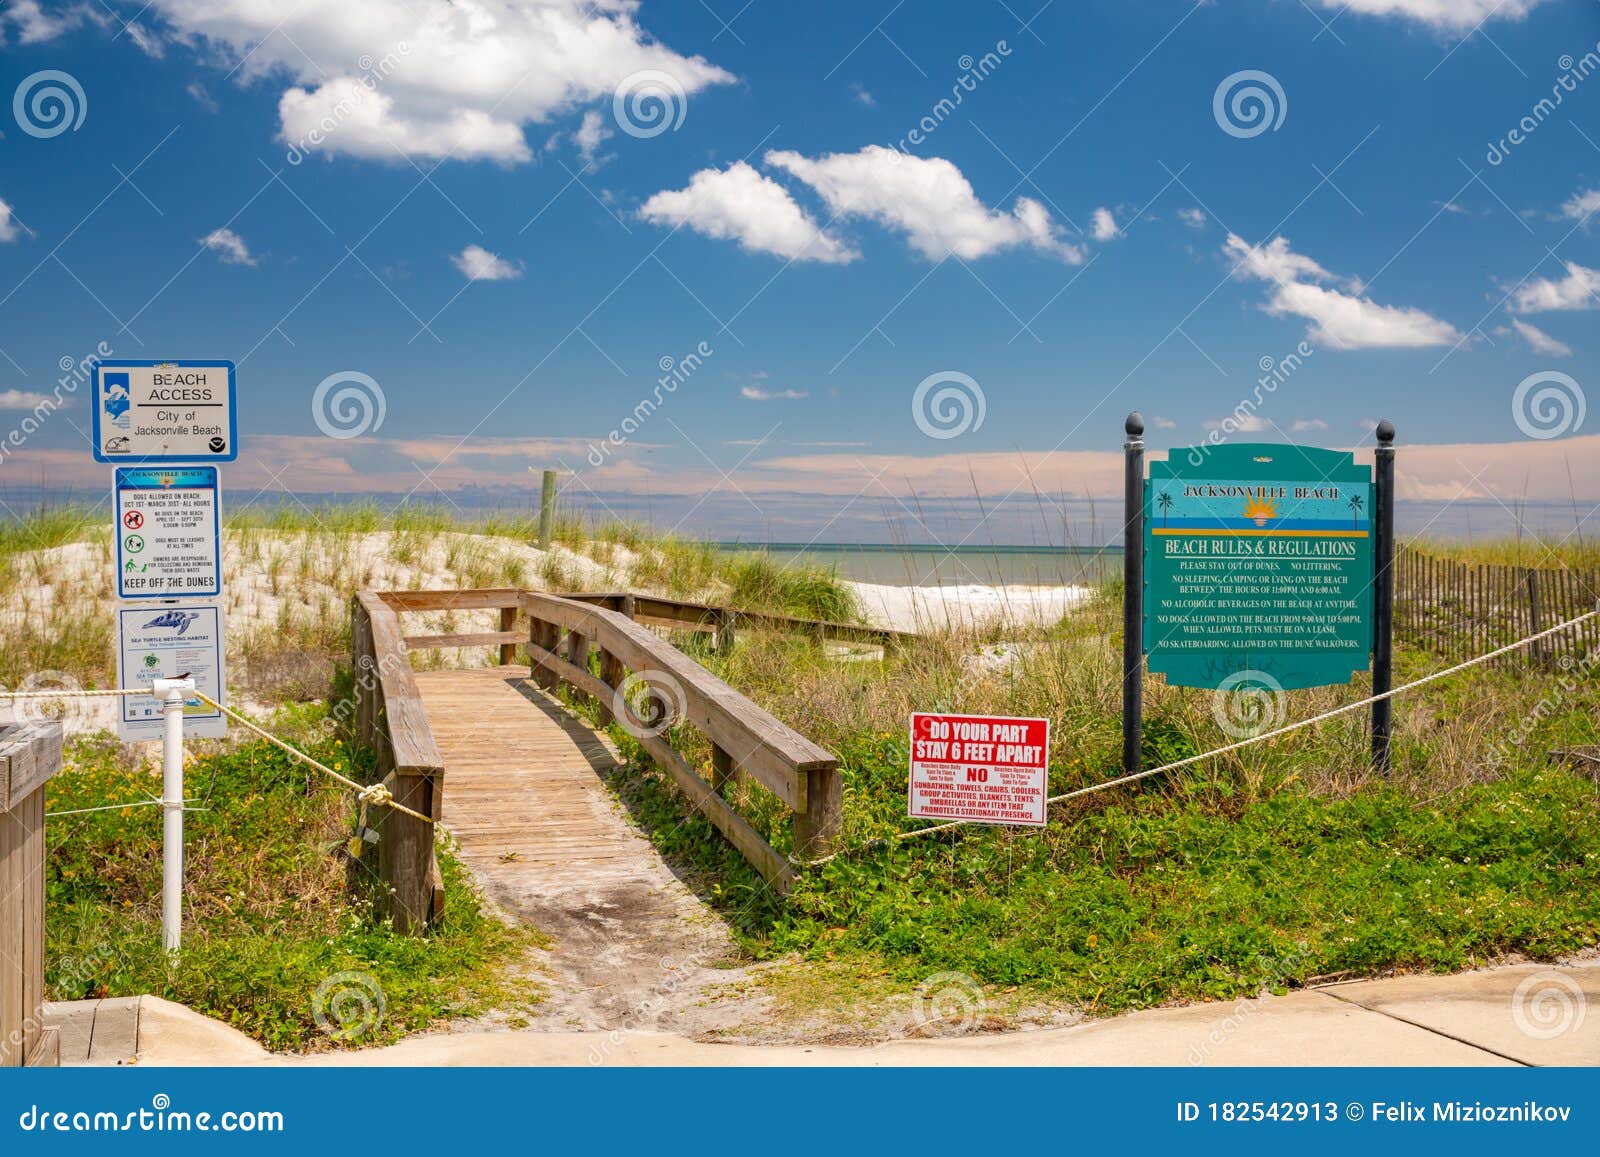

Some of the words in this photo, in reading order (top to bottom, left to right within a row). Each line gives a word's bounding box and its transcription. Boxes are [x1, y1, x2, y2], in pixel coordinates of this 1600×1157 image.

[153, 374, 206, 386] BEACH
[149, 389, 212, 401] ACCESS
[157, 411, 179, 423] City
[185, 411, 196, 421] of
[135, 426, 189, 436] Jacksonville
[192, 425, 222, 435] Beach
[1184, 485, 1286, 499] JACKSONVILLE
[1295, 487, 1339, 499] BEACH
[1165, 539, 1207, 554] BEACH
[1212, 539, 1252, 555] RULES
[1255, 540, 1265, 555] &
[1269, 541, 1356, 556] REGULATIONS
[1180, 562, 1206, 570] PLEASE
[1208, 562, 1225, 570] STAY
[1228, 562, 1242, 570] OUT
[1243, 562, 1254, 570] OF
[1291, 562, 1301, 571] NO
[124, 578, 146, 588] KEEP
[149, 578, 165, 588] OFF
[168, 577, 183, 587] THE
[187, 577, 214, 587] DUNES
[1172, 575, 1183, 584] NO
[1223, 575, 1257, 584] CAMPING
[1259, 575, 1270, 584] OR
[1271, 575, 1294, 584] LYING
[1295, 575, 1305, 584] ON
[1308, 575, 1322, 584] THE
[1323, 575, 1348, 584] BEACH
[1180, 586, 1215, 594] BETWEEN
[1219, 586, 1234, 594] THE
[1235, 586, 1259, 594] HOURS
[1260, 586, 1270, 594] OF
[1301, 586, 1313, 594] AND
[1161, 600, 1172, 608] NO
[1174, 600, 1216, 608] ALCOHOLIC
[1218, 600, 1260, 608] BEVERAGES
[1261, 600, 1271, 608] ON
[1273, 600, 1287, 608] THE
[1288, 600, 1312, 608] BEACH
[1314, 600, 1323, 608] AT
[1157, 615, 1168, 624] NO
[1170, 615, 1189, 624] DOGS
[1190, 615, 1226, 624] ALLOWED
[1227, 615, 1237, 624] ON
[1240, 615, 1253, 624] THE
[1255, 615, 1279, 624] BEACH
[1280, 615, 1300, 624] FROM
[1327, 615, 1336, 624] TO
[1183, 625, 1205, 634] WHEN
[1244, 625, 1261, 634] PETS
[1263, 625, 1281, 634] MUST
[1284, 625, 1294, 634] BE
[1294, 625, 1304, 634] ON
[1306, 625, 1311, 634] A
[1158, 640, 1169, 648] NO
[1170, 640, 1230, 648] SKATEBOARDING
[1231, 640, 1266, 648] ALLOWED
[1268, 640, 1278, 648] ON
[1280, 640, 1294, 648] THE
[1295, 640, 1313, 648] DUNE
[930, 721, 950, 740] DO
[952, 722, 990, 742] YOUR
[992, 724, 1029, 744] PART
[916, 740, 949, 759] STAY
[951, 742, 961, 760] 6
[964, 743, 995, 762] FEET
[996, 744, 1042, 764] APART
[967, 767, 988, 783] NO
[930, 798, 967, 807] UMBRELLAS
[977, 801, 990, 809] ANY
[921, 806, 954, 815] PROMOTES
[955, 807, 960, 815] A
[961, 808, 999, 817] STATIONARY
[1000, 810, 1033, 819] PRESENCE
